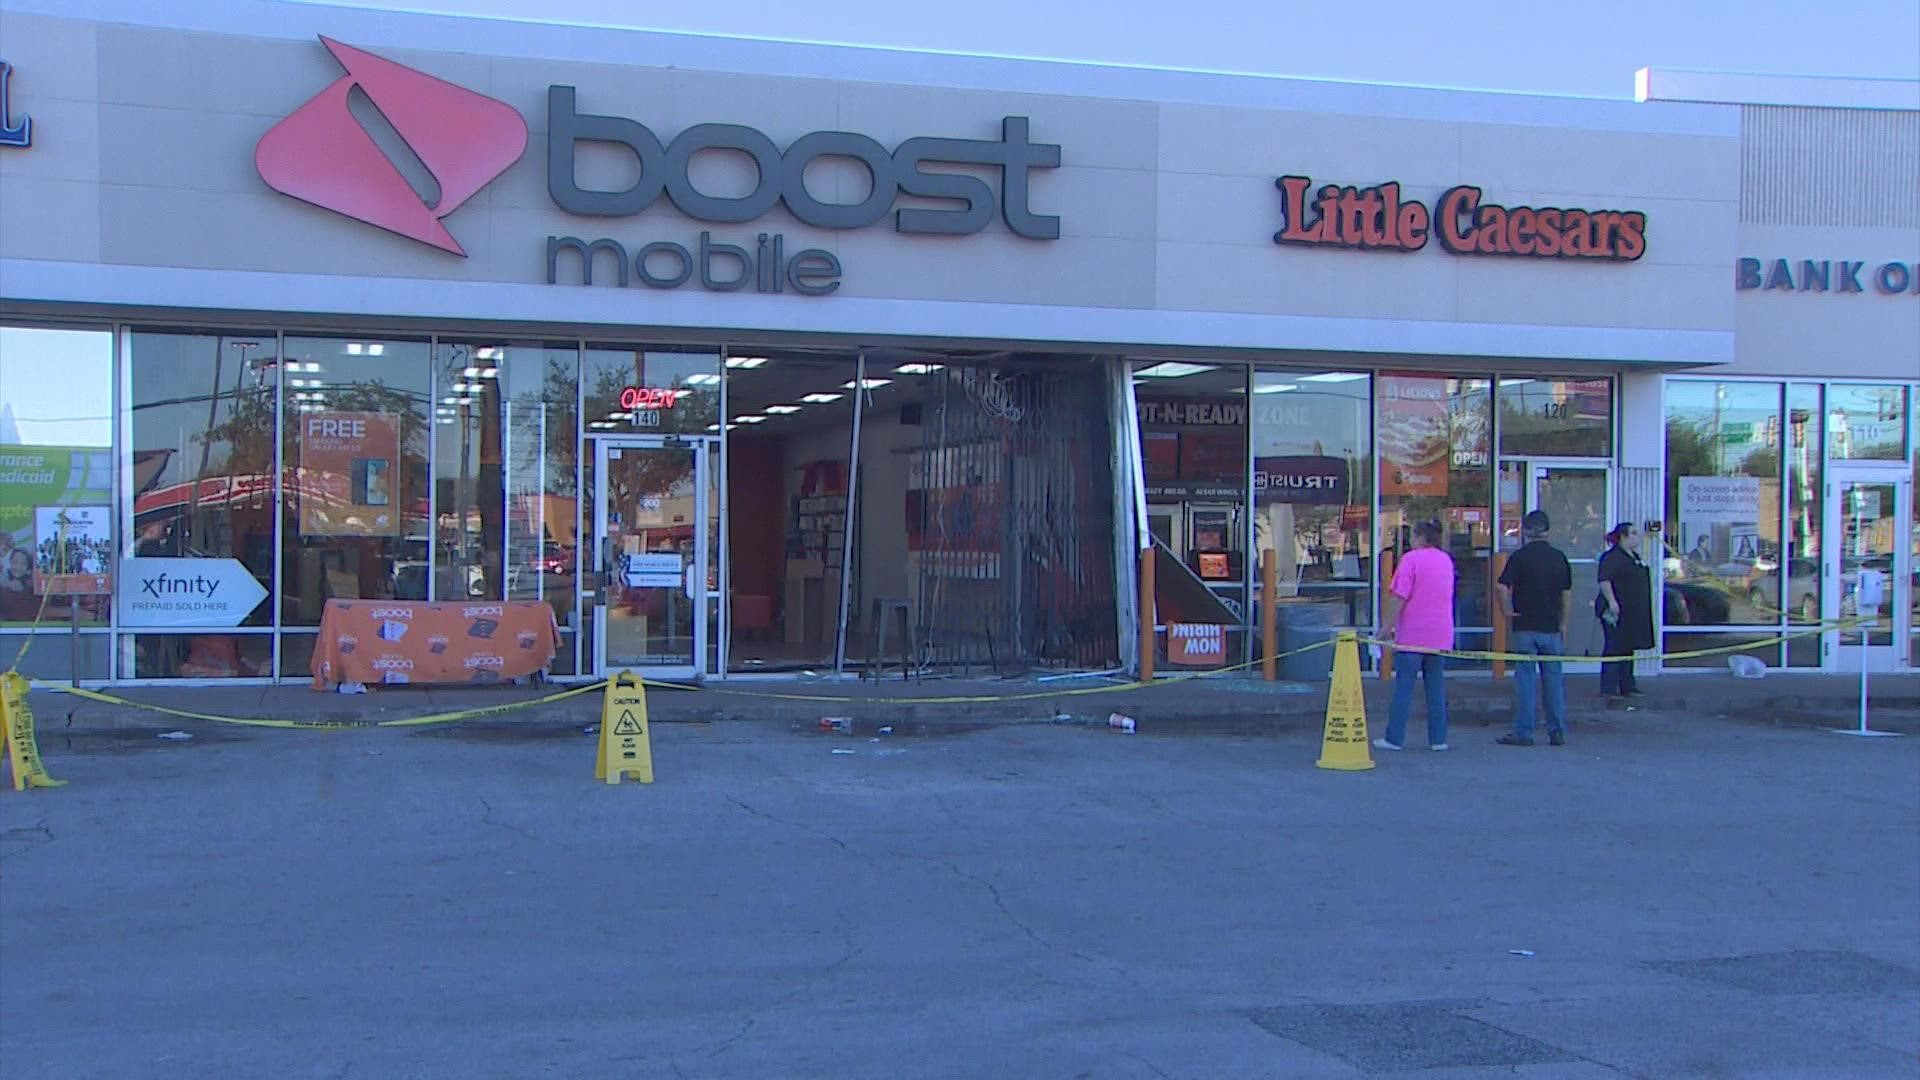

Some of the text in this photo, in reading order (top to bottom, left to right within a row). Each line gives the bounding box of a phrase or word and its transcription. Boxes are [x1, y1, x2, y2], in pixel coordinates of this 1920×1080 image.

[548, 85, 1061, 240] boost
[1275, 175, 1647, 263] Little Caesars
[547, 231, 842, 296] mobile
[1736, 258, 1864, 292] BANK
[620, 386, 678, 409] OPEN
[634, 411, 659, 426] 140
[1140, 402, 1312, 425] T-N-READY ZONE
[1543, 403, 1567, 420] 120
[308, 419, 366, 438] FREE
[1453, 451, 1488, 466] OPEN
[142, 572, 220, 598] xfinity
[132, 602, 228, 611] PREPAID SOLD HERE
[1184, 638, 1221, 655] NOW
